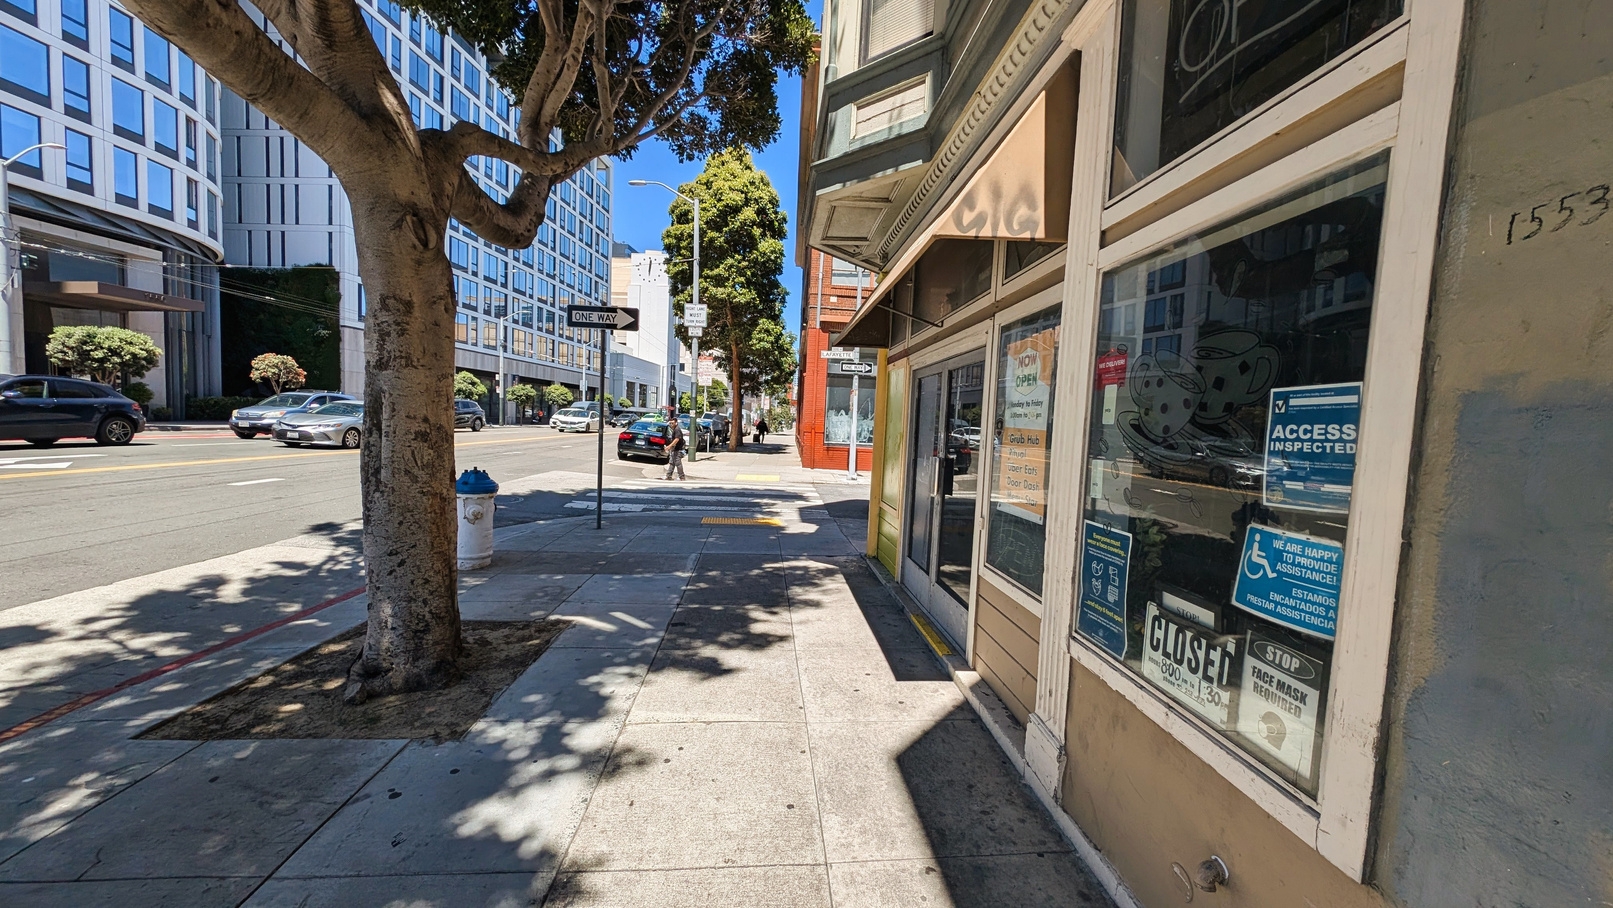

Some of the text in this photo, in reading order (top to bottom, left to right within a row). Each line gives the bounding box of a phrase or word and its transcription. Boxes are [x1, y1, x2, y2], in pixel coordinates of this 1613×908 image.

[1506, 183, 1610, 246] 1553
[574, 312, 616, 322] ONE WAY
[1017, 352, 1038, 369] NOW
[1015, 372, 1038, 388] OPEN
[1031, 398, 1043, 408] Friday
[1009, 433, 1040, 445] Grub Hub
[1272, 424, 1356, 440] ACCESS
[1270, 442, 1356, 454] INSPECTED
[1007, 463, 1038, 476] Uber Eats
[1007, 476, 1040, 491] Door Dash
[1025, 495, 1038, 507] Star
[1093, 532, 1110, 542] Everyone
[1273, 539, 1338, 562] WE ARE HAPPY
[1282, 552, 1338, 574] TO PROVIDE
[1276, 562, 1336, 585] ASSISTANCE!
[1270, 592, 1336, 618] ENCANTADOS A
[1292, 588, 1336, 607] ESTAMOS
[1246, 594, 1335, 630] PRESTAR ASSISTENCIA
[1150, 614, 1235, 688] CLOSED
[1266, 646, 1300, 672] STOP
[1161, 658, 1181, 681] 8:00
[1189, 680, 1195, 688] to
[1199, 678, 1221, 706] 1:30
[1162, 675, 1175, 688] phone
[1252, 665, 1308, 706] FACE MASK
[1253, 681, 1302, 719] REQUIRED
